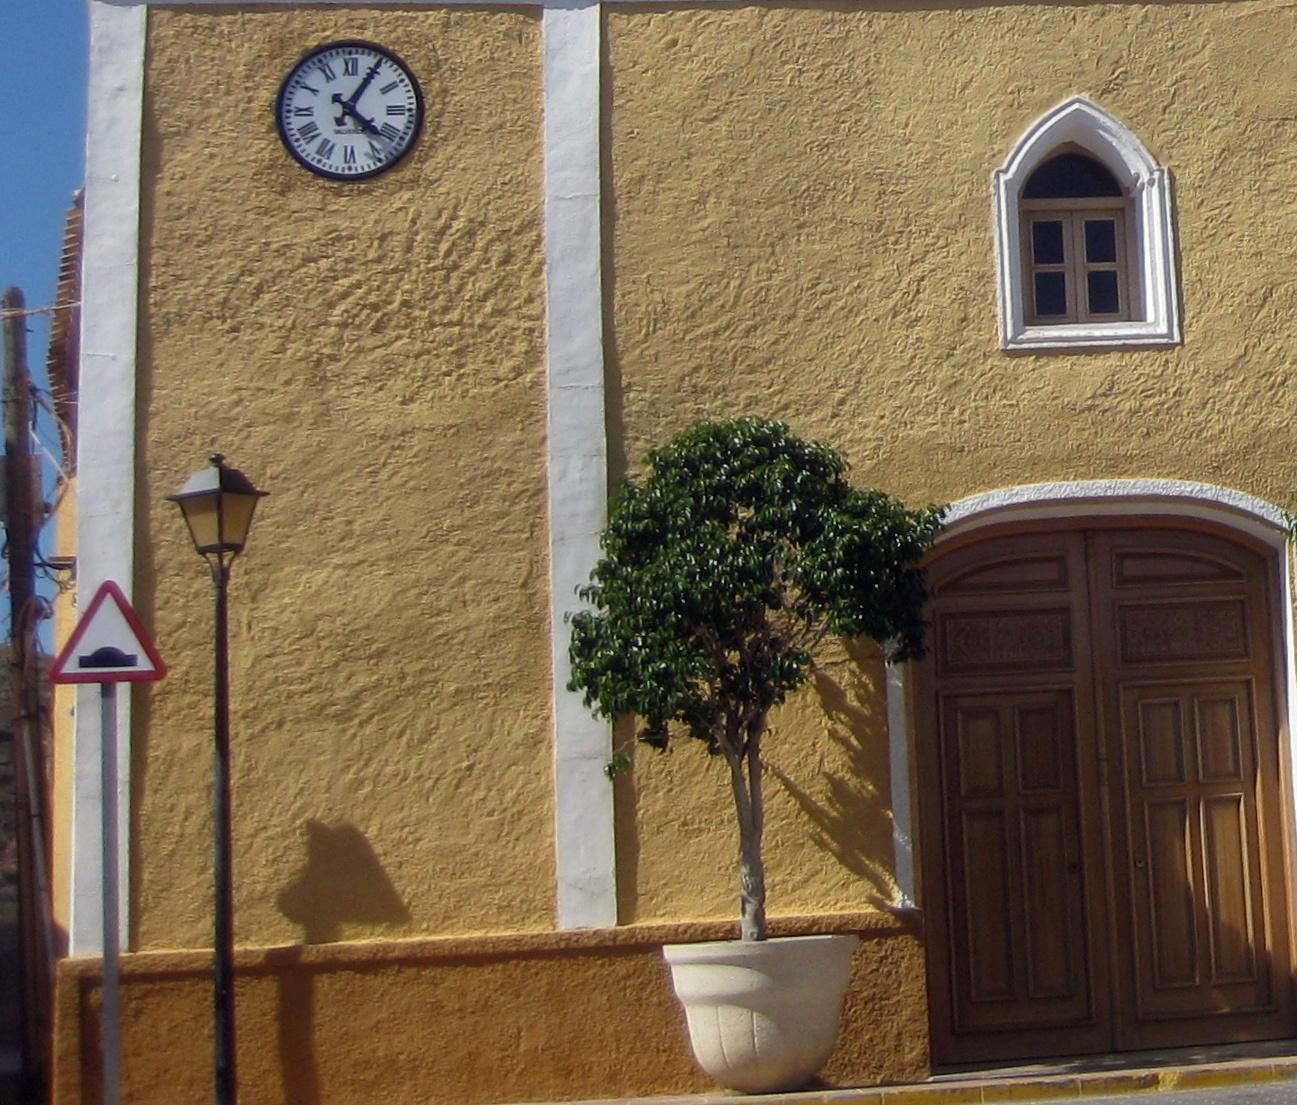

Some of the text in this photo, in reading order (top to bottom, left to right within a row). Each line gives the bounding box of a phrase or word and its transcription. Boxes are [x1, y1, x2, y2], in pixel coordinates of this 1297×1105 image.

[318, 62, 336, 83] XI
[342, 57, 358, 76] XII
[300, 82, 320, 96] X
[379, 81, 399, 95] II
[294, 106, 314, 117] IX
[386, 105, 406, 116] III
[297, 121, 321, 144] VIII
[316, 138, 336, 160] VII
[344, 145, 356, 164] VI
